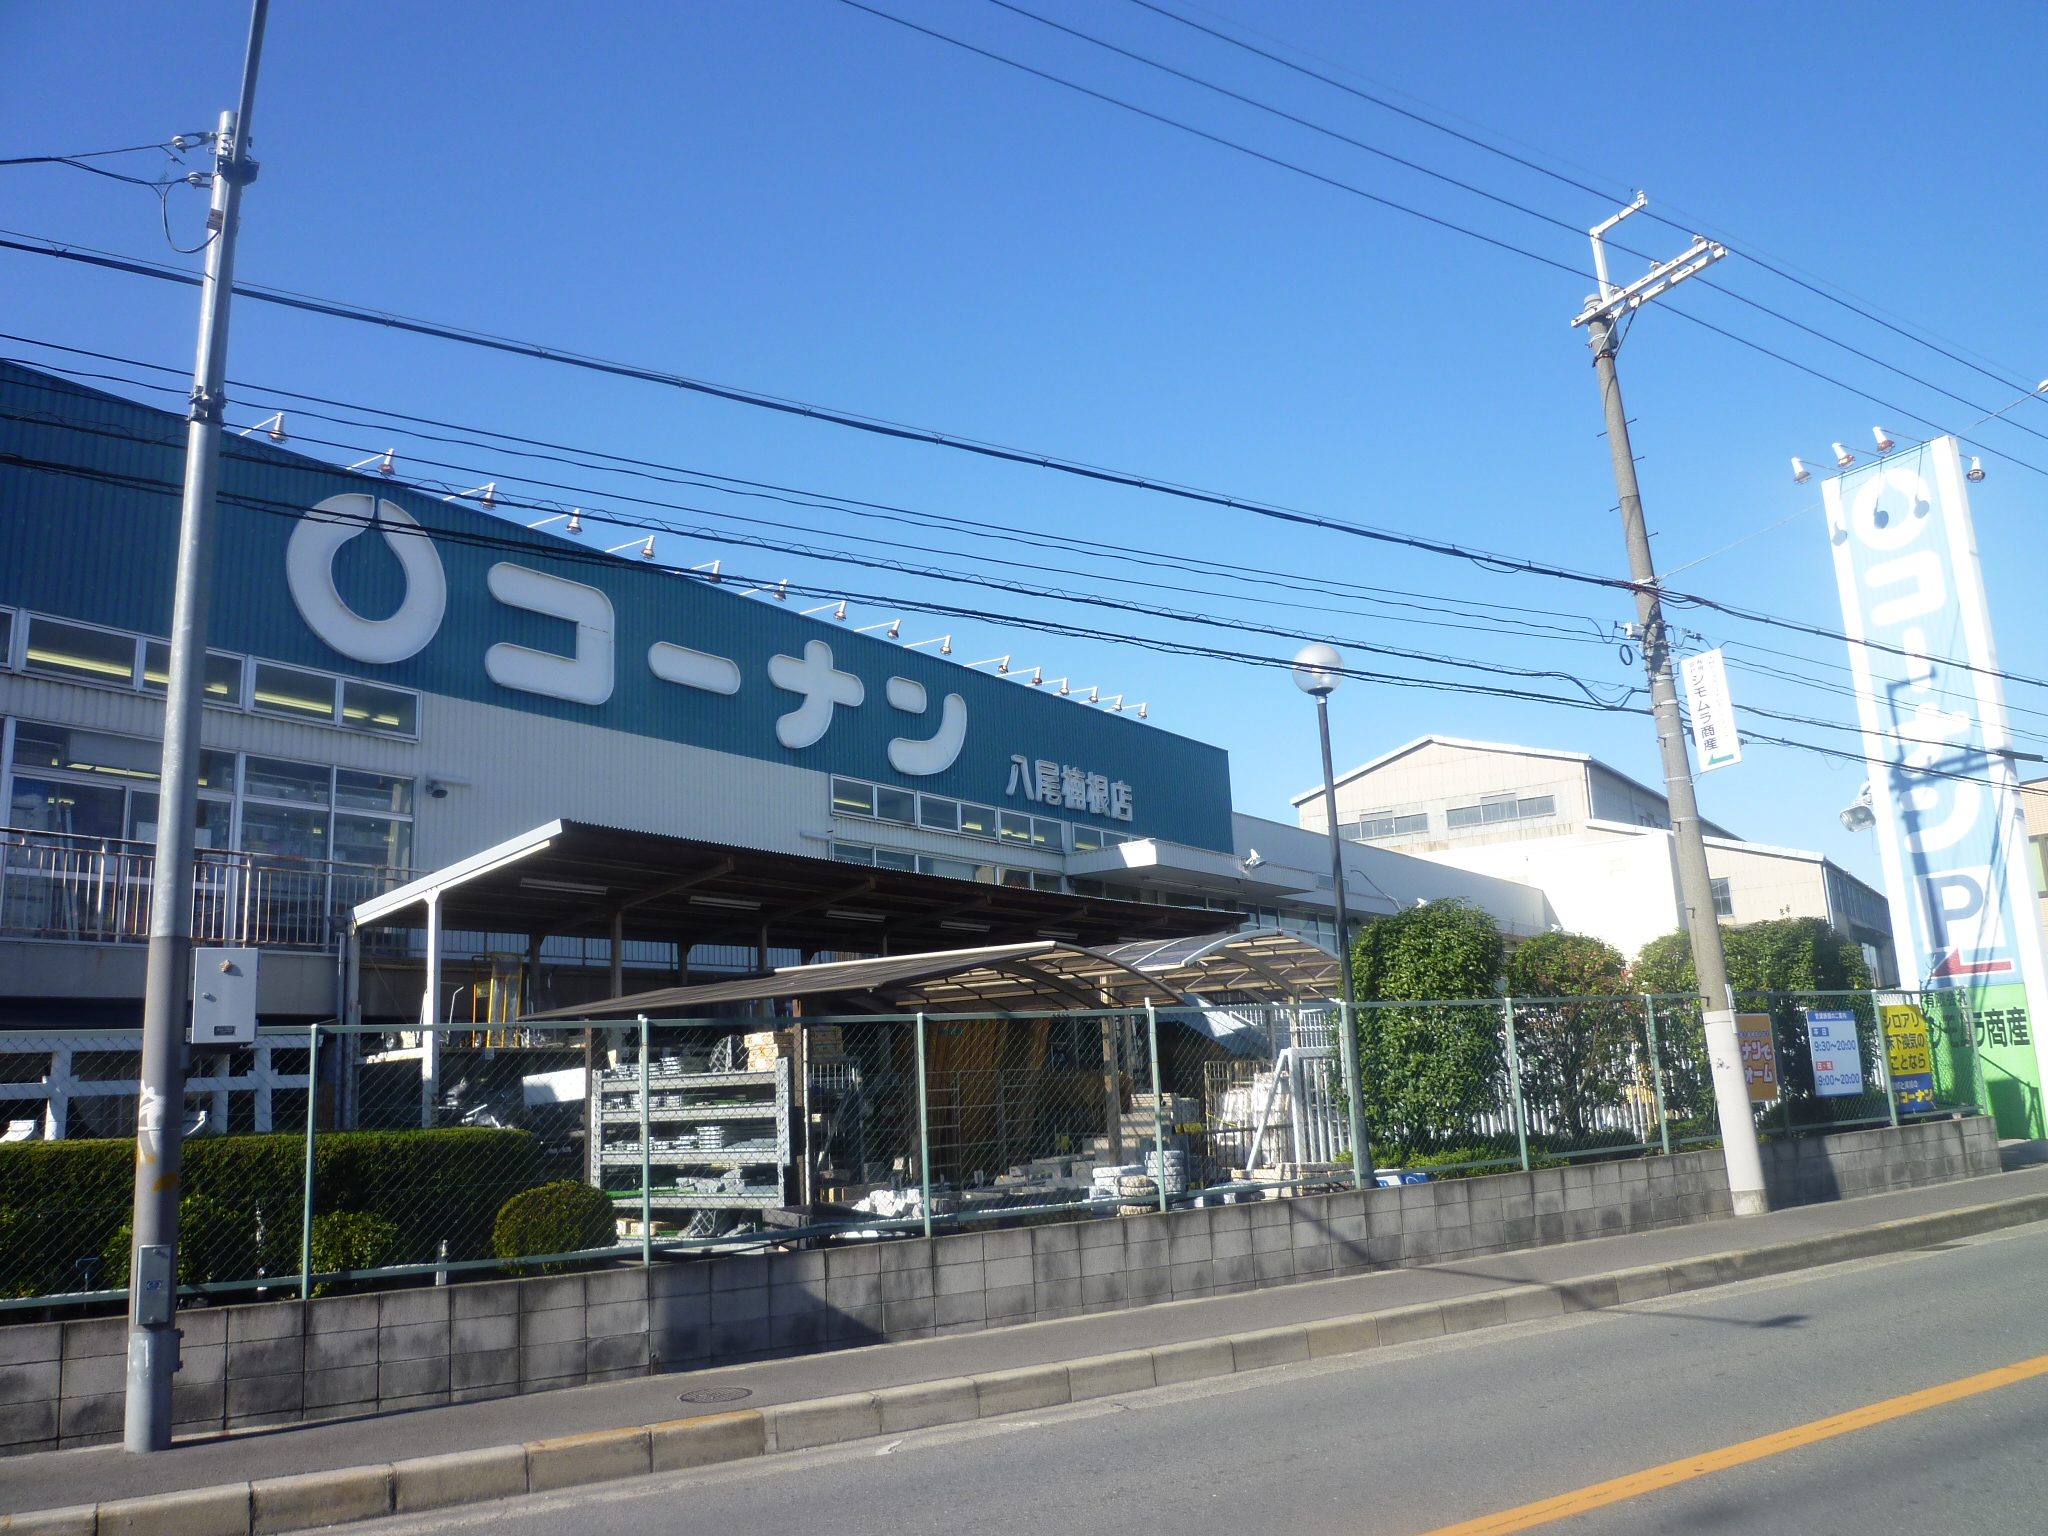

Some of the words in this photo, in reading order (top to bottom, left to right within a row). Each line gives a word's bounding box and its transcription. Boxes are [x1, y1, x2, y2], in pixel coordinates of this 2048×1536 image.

[486, 562, 967, 776] コーナン
[1865, 551, 1980, 853] コーナン
[1692, 675, 1718, 751] シモムラ商産
[1926, 875, 1984, 948] P
[1883, 1012, 1919, 1028] シロアリ
